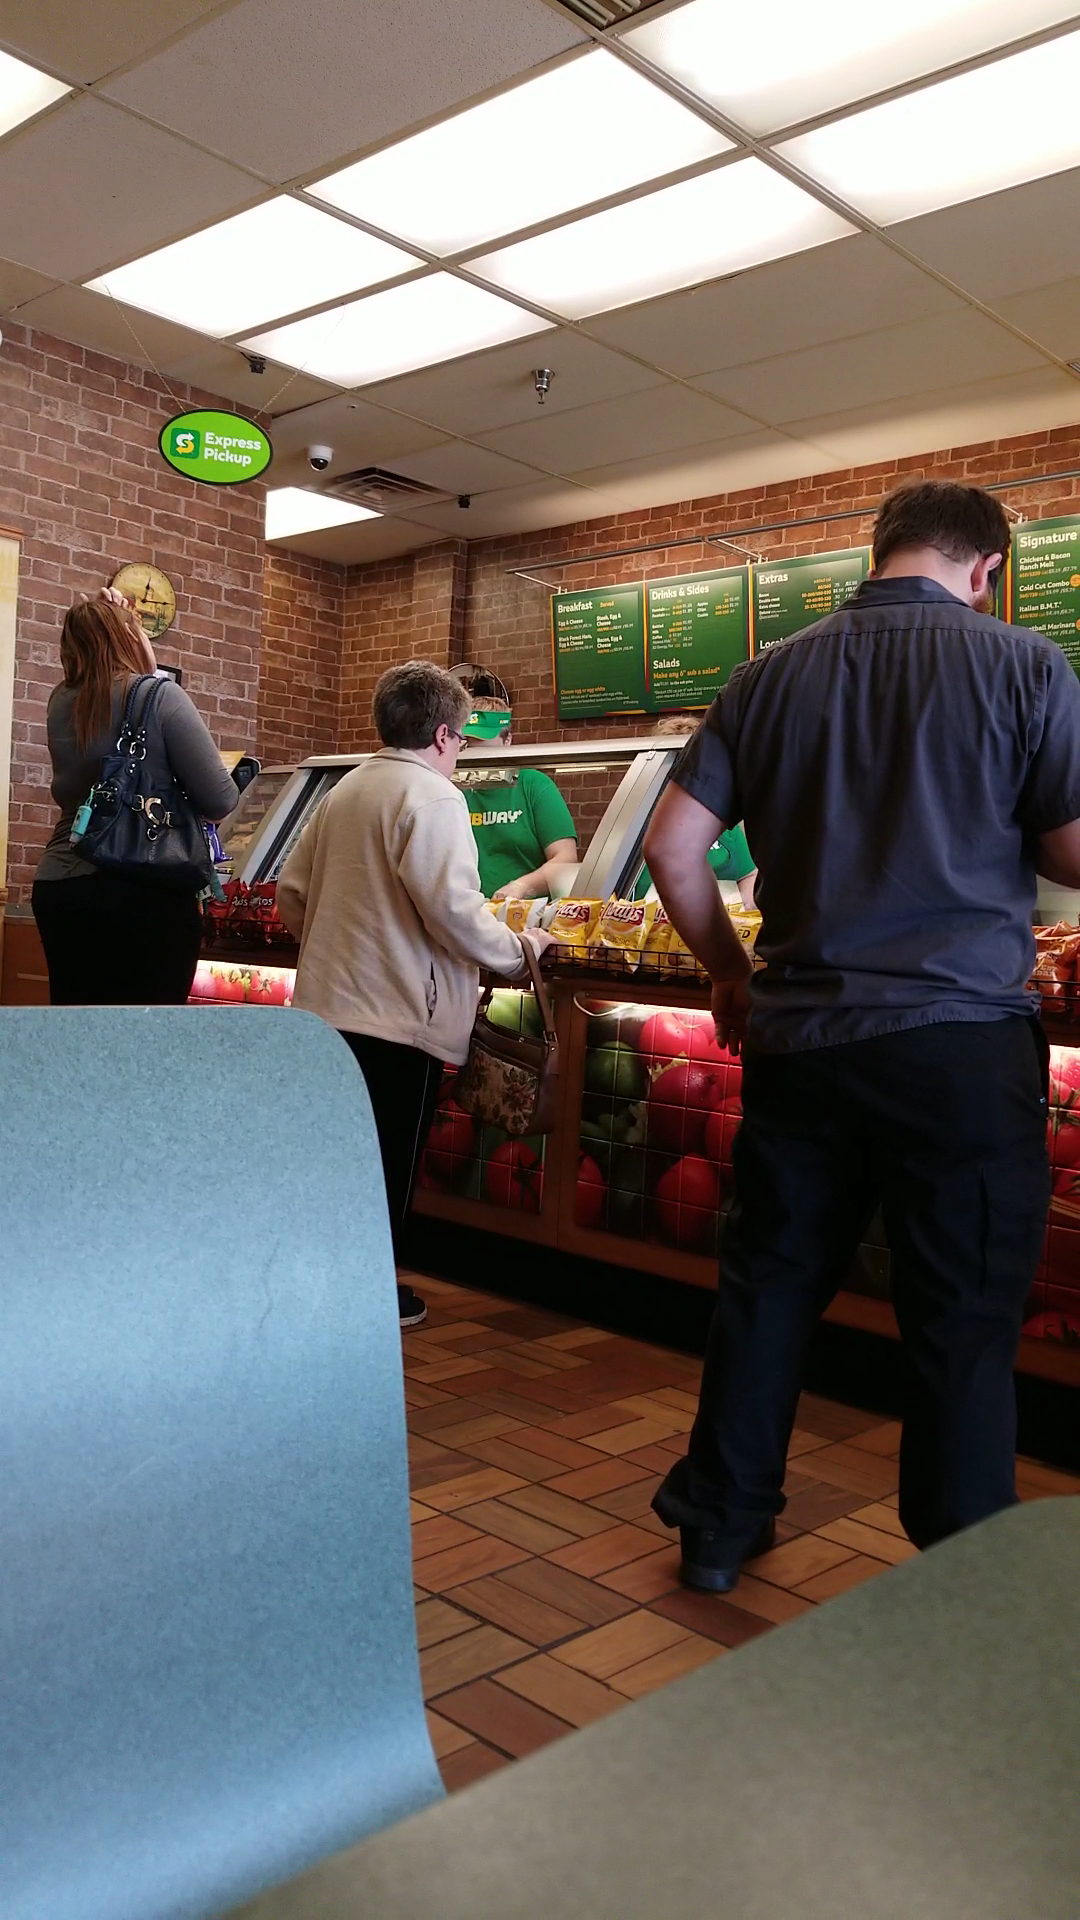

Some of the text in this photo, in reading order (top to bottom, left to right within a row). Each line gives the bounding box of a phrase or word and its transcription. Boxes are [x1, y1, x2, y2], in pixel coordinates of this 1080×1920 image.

[205, 431, 261, 450] Express
[204, 447, 252, 467] Pickup
[1019, 531, 1078, 549] Signature
[1019, 556, 1044, 564] Chicken
[1050, 552, 1071, 560] Bacon
[1019, 561, 1055, 571] Ranch Melt
[758, 573, 788, 585] Extras
[1019, 584, 1034, 592] Cold
[1047, 580, 1070, 588] Combo
[651, 585, 710, 600] Drinks & Sides
[557, 600, 593, 614] Breakfast
[1019, 604, 1040, 612] Italian
[1047, 622, 1076, 630] Marinara
[653, 657, 680, 669] Salads
[469, 810, 523, 826] BWAY
